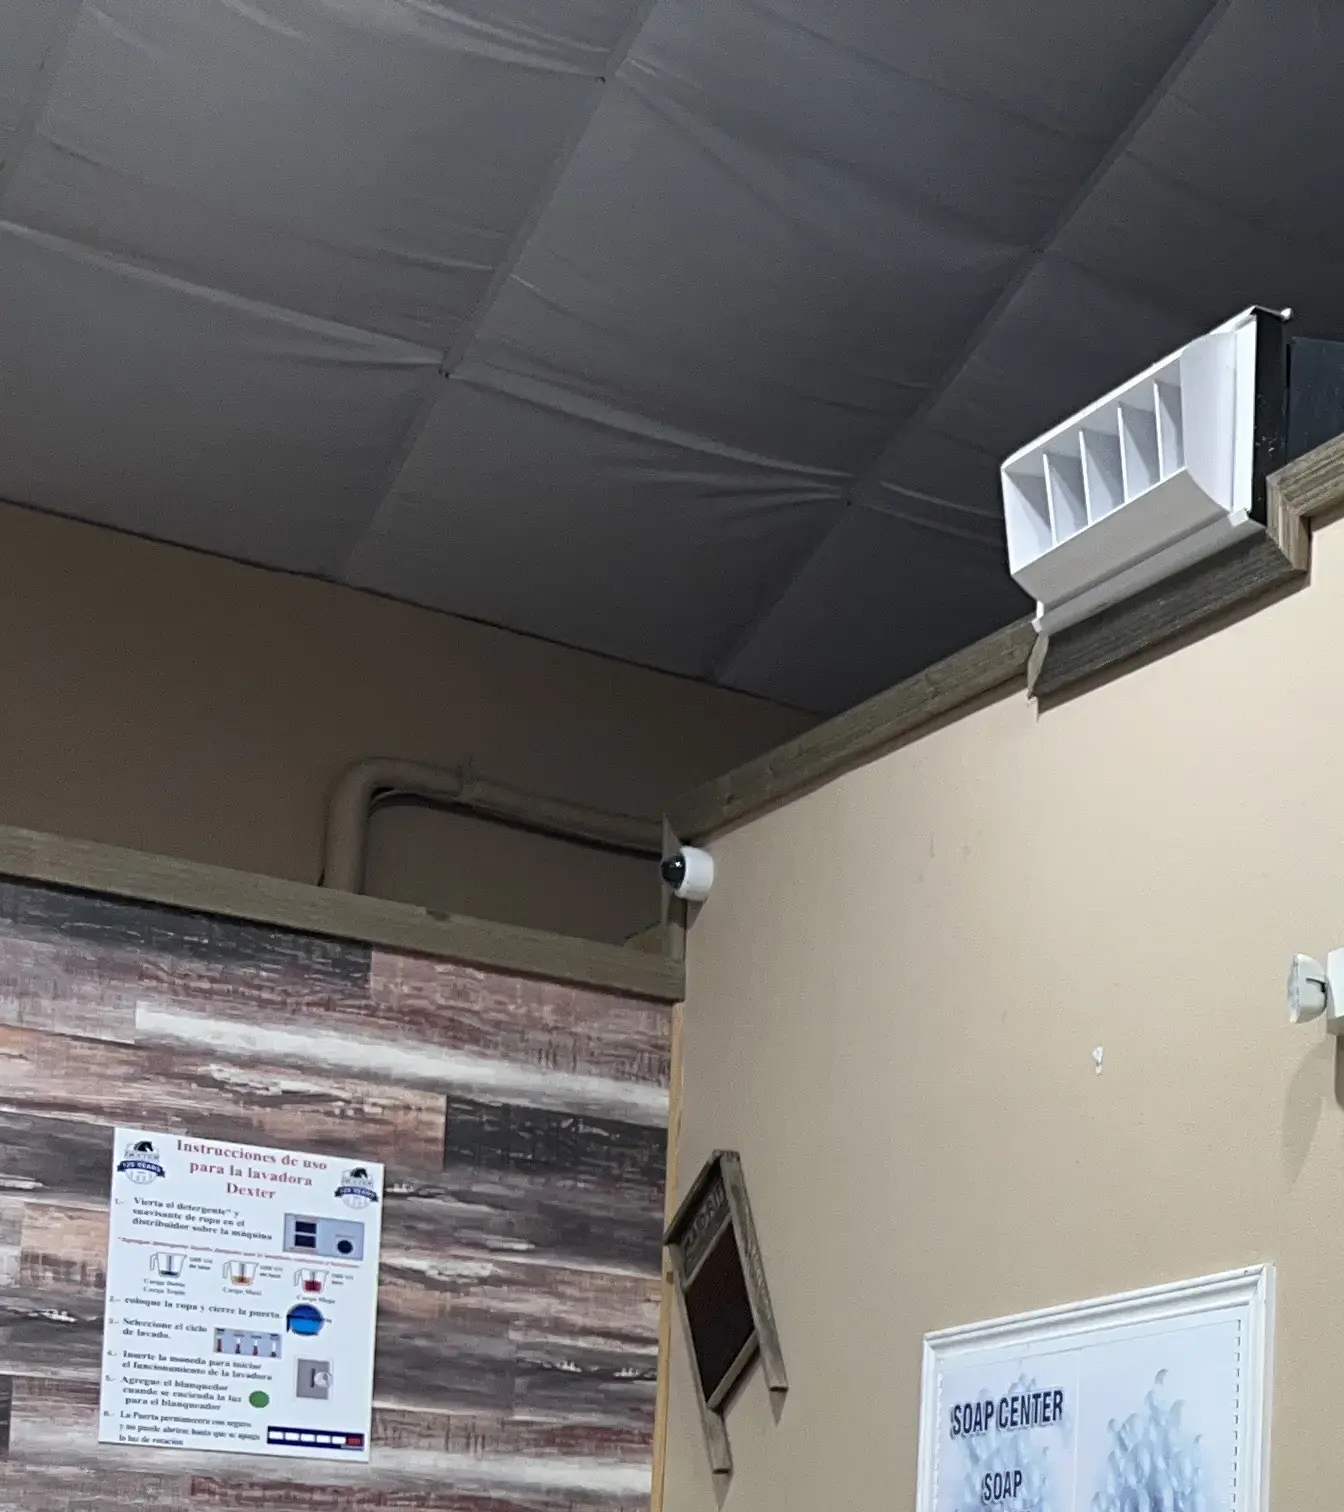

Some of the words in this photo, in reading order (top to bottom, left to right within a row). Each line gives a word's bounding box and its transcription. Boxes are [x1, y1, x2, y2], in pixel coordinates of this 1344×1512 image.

[177, 1139, 276, 1164] Instrucciones
[281, 1153, 299, 1167] de
[303, 1159, 328, 1171] uso
[189, 1162, 225, 1176] para
[230, 1164, 242, 1177] la
[247, 1167, 313, 1186] lavadora
[226, 1182, 277, 1200] Dexter
[951, 1400, 994, 1436] SOAP
[999, 1389, 1063, 1428] CENTER
[983, 1470, 1022, 1501] SOAP
